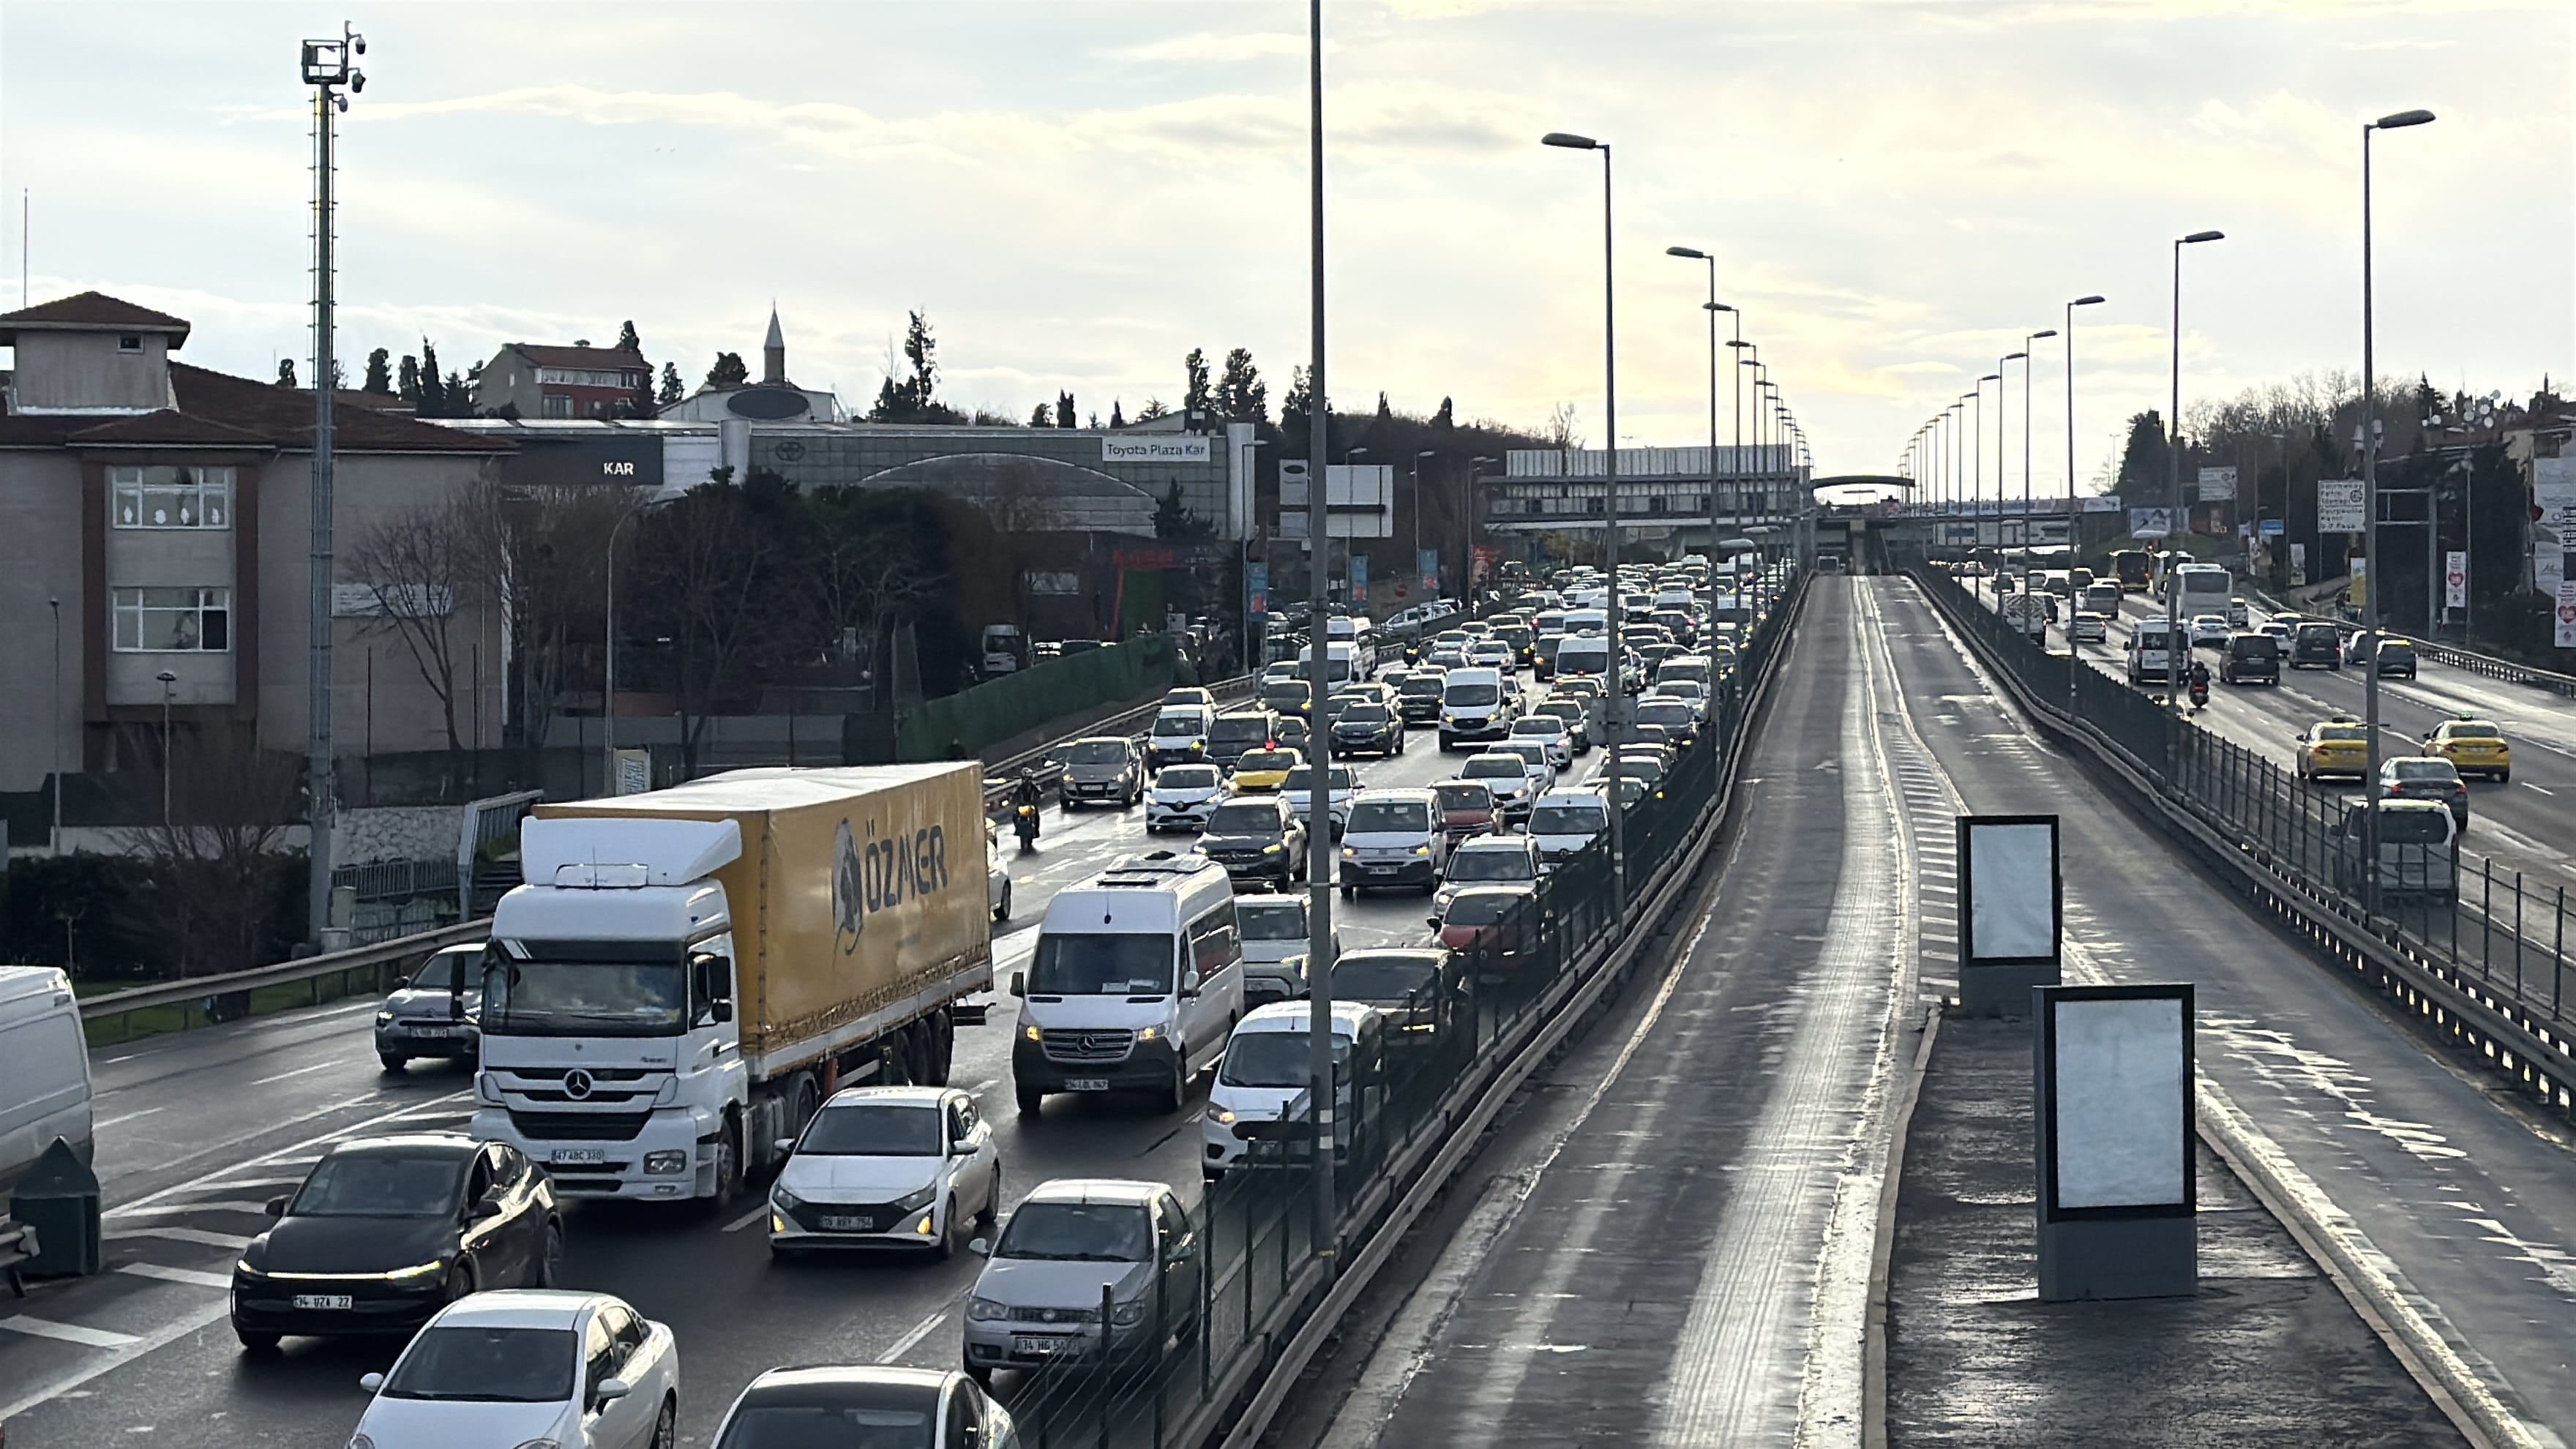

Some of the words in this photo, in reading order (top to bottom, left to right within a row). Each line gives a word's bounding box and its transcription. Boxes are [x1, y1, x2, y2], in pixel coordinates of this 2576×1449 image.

[1107, 443, 1147, 457] Toyota
[1150, 444, 1183, 455] Plaza
[1185, 444, 1205, 454] Kar
[604, 462, 634, 475] KAR
[865, 818, 948, 913] ÖZMER
